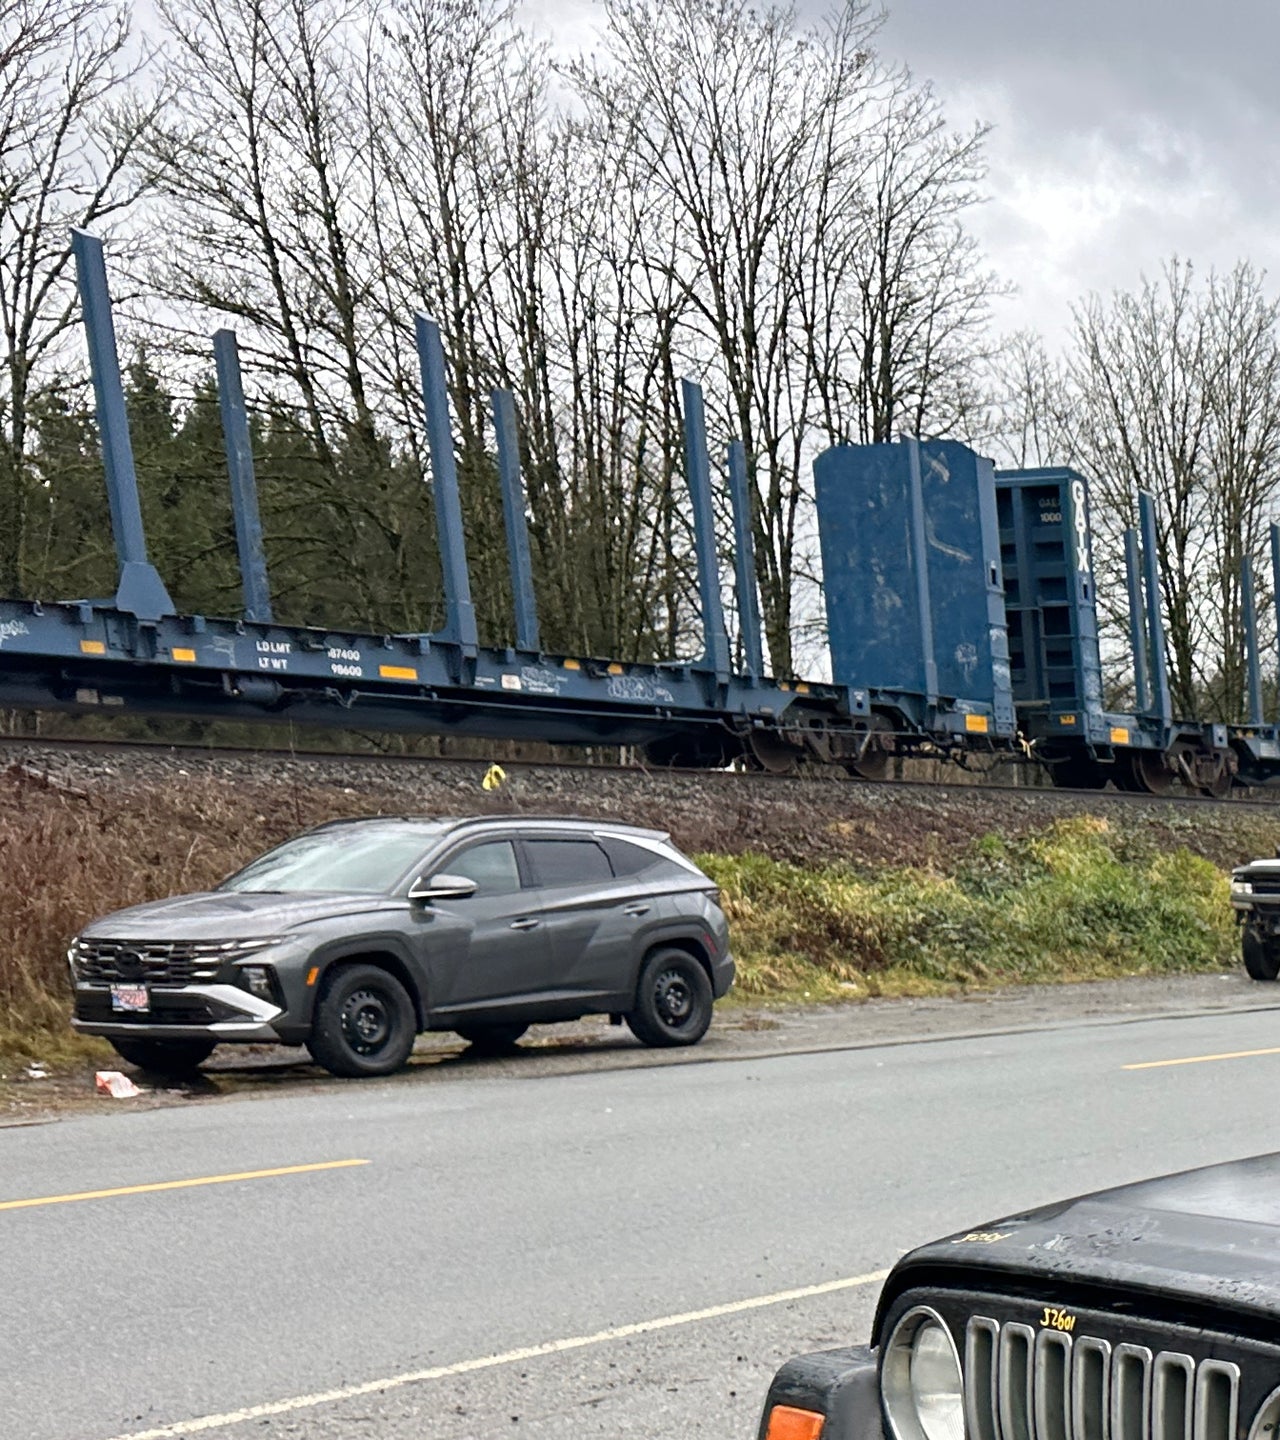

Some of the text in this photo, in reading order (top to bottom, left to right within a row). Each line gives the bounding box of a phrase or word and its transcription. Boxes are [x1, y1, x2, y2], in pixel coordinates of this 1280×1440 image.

[1072, 480, 1090, 573] GATX
[256, 641, 270, 652] LD
[271, 641, 291, 654] LMT
[259, 657, 362, 677] LT WT 98600
[1040, 1307, 1076, 1331] J2601
